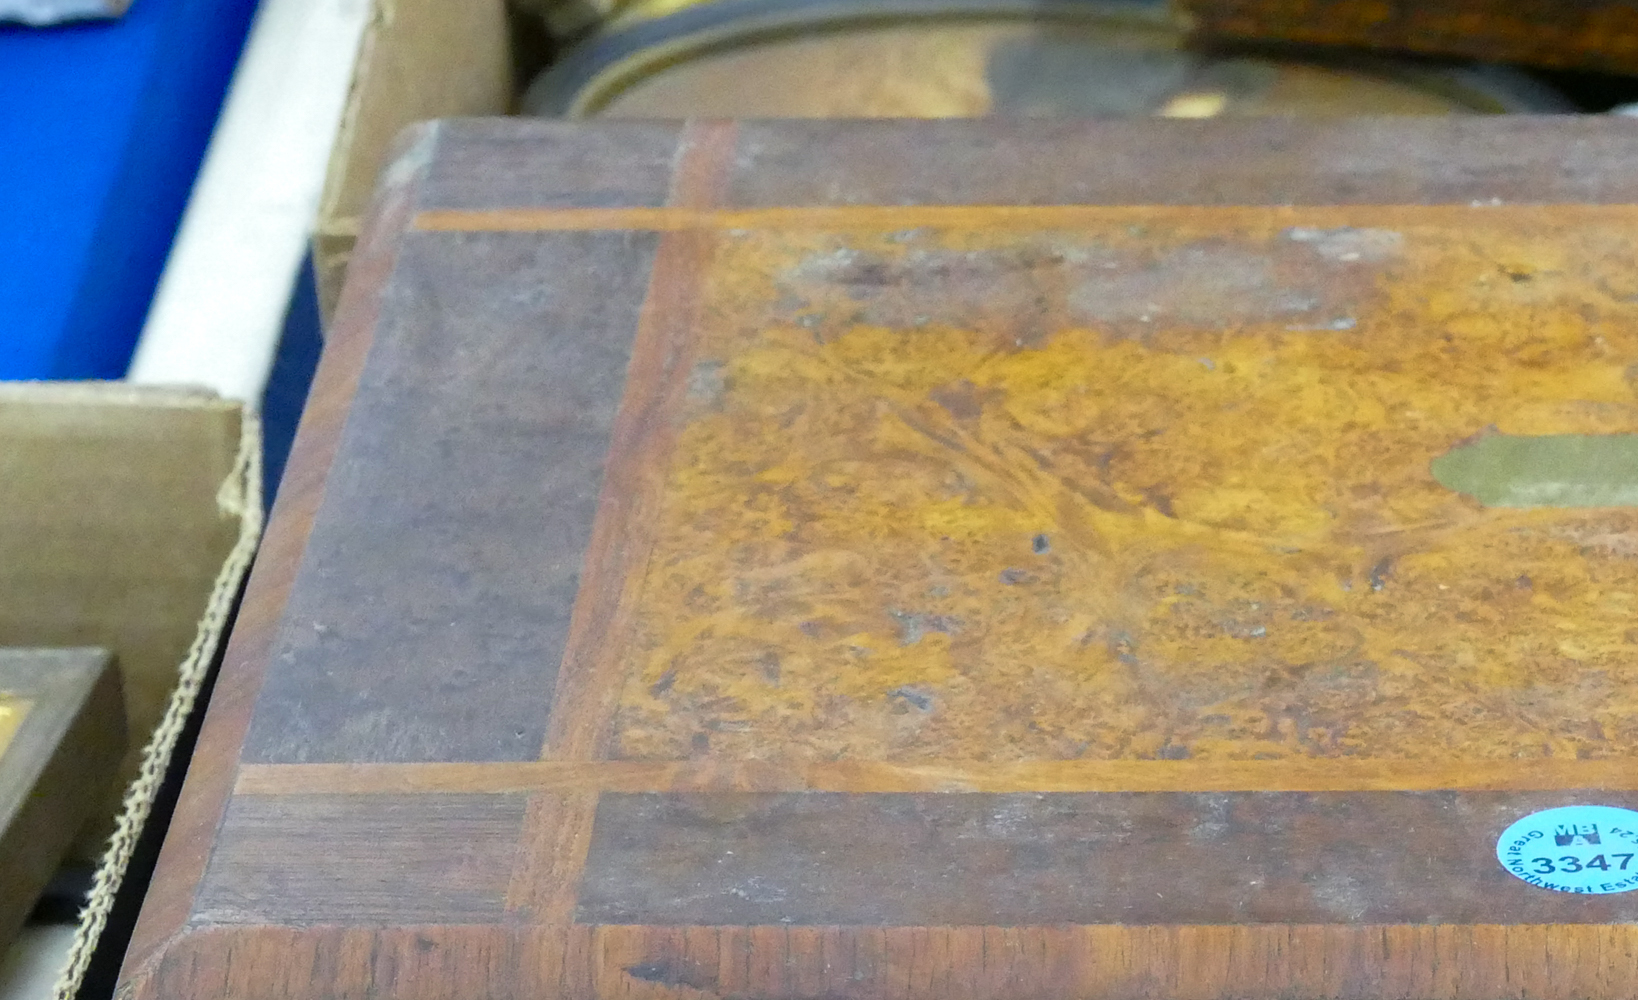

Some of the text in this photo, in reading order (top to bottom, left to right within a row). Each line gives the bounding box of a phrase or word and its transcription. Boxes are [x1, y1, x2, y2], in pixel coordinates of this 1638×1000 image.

[1508, 829, 1544, 856] Great
[1507, 858, 1594, 894] Northwest
[1531, 852, 1635, 874] 3347
